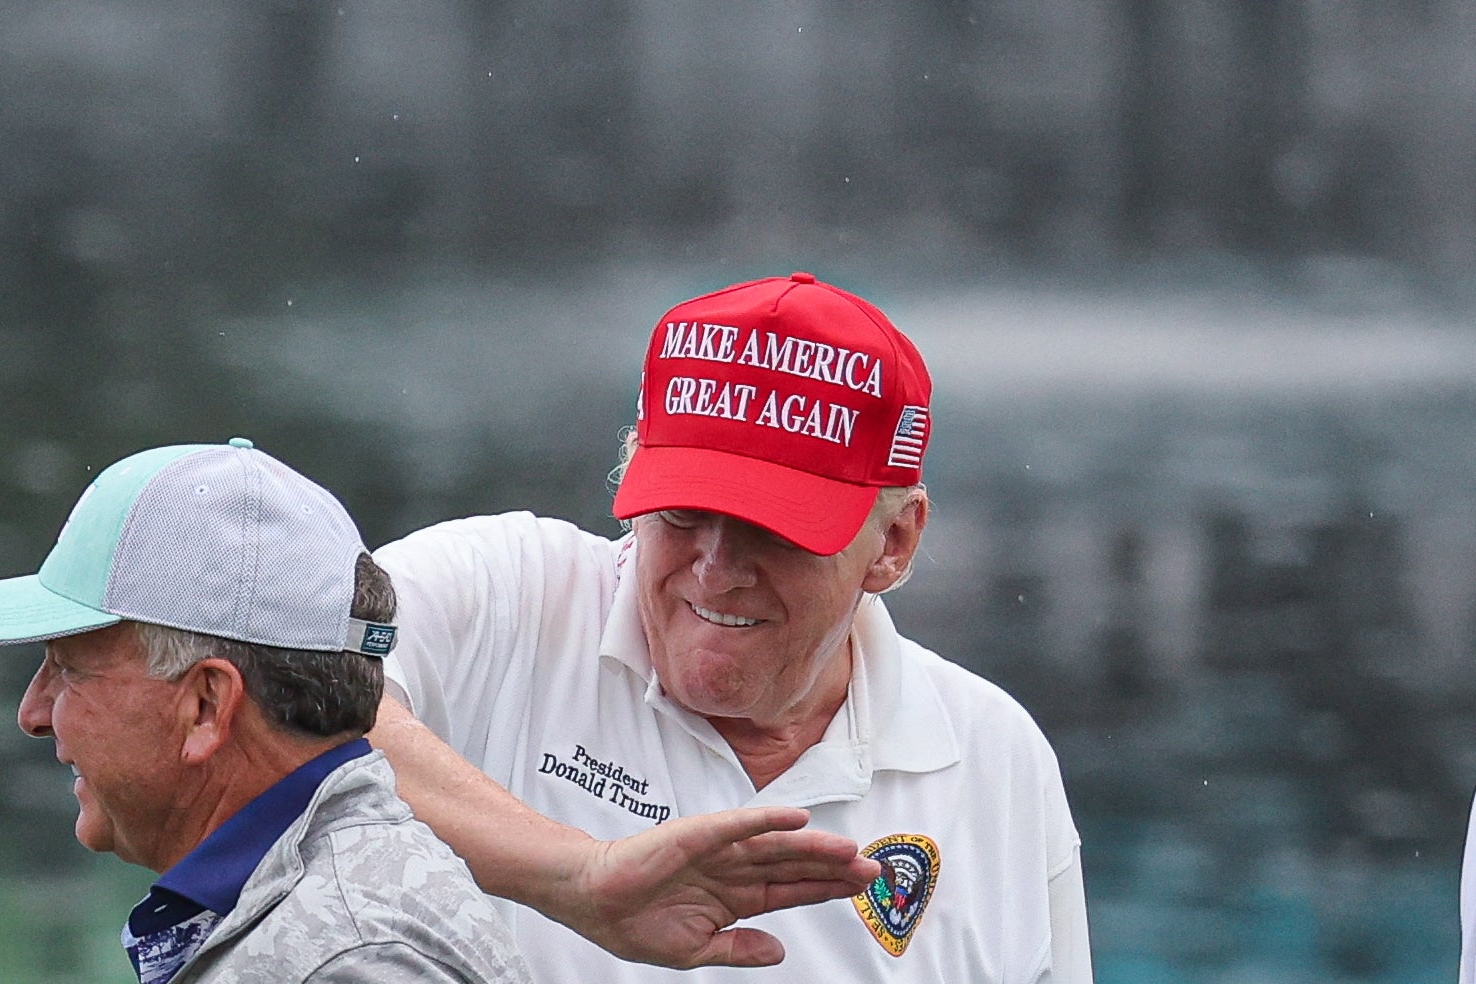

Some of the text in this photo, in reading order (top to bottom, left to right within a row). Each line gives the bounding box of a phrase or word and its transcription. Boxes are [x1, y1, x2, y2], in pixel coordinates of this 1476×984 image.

[659, 321, 883, 399] MAKE AMERICA
[665, 376, 757, 423] GREAT
[755, 389, 860, 448] AGAIN
[538, 752, 671, 826] Donald Trump
[572, 744, 650, 796] President
